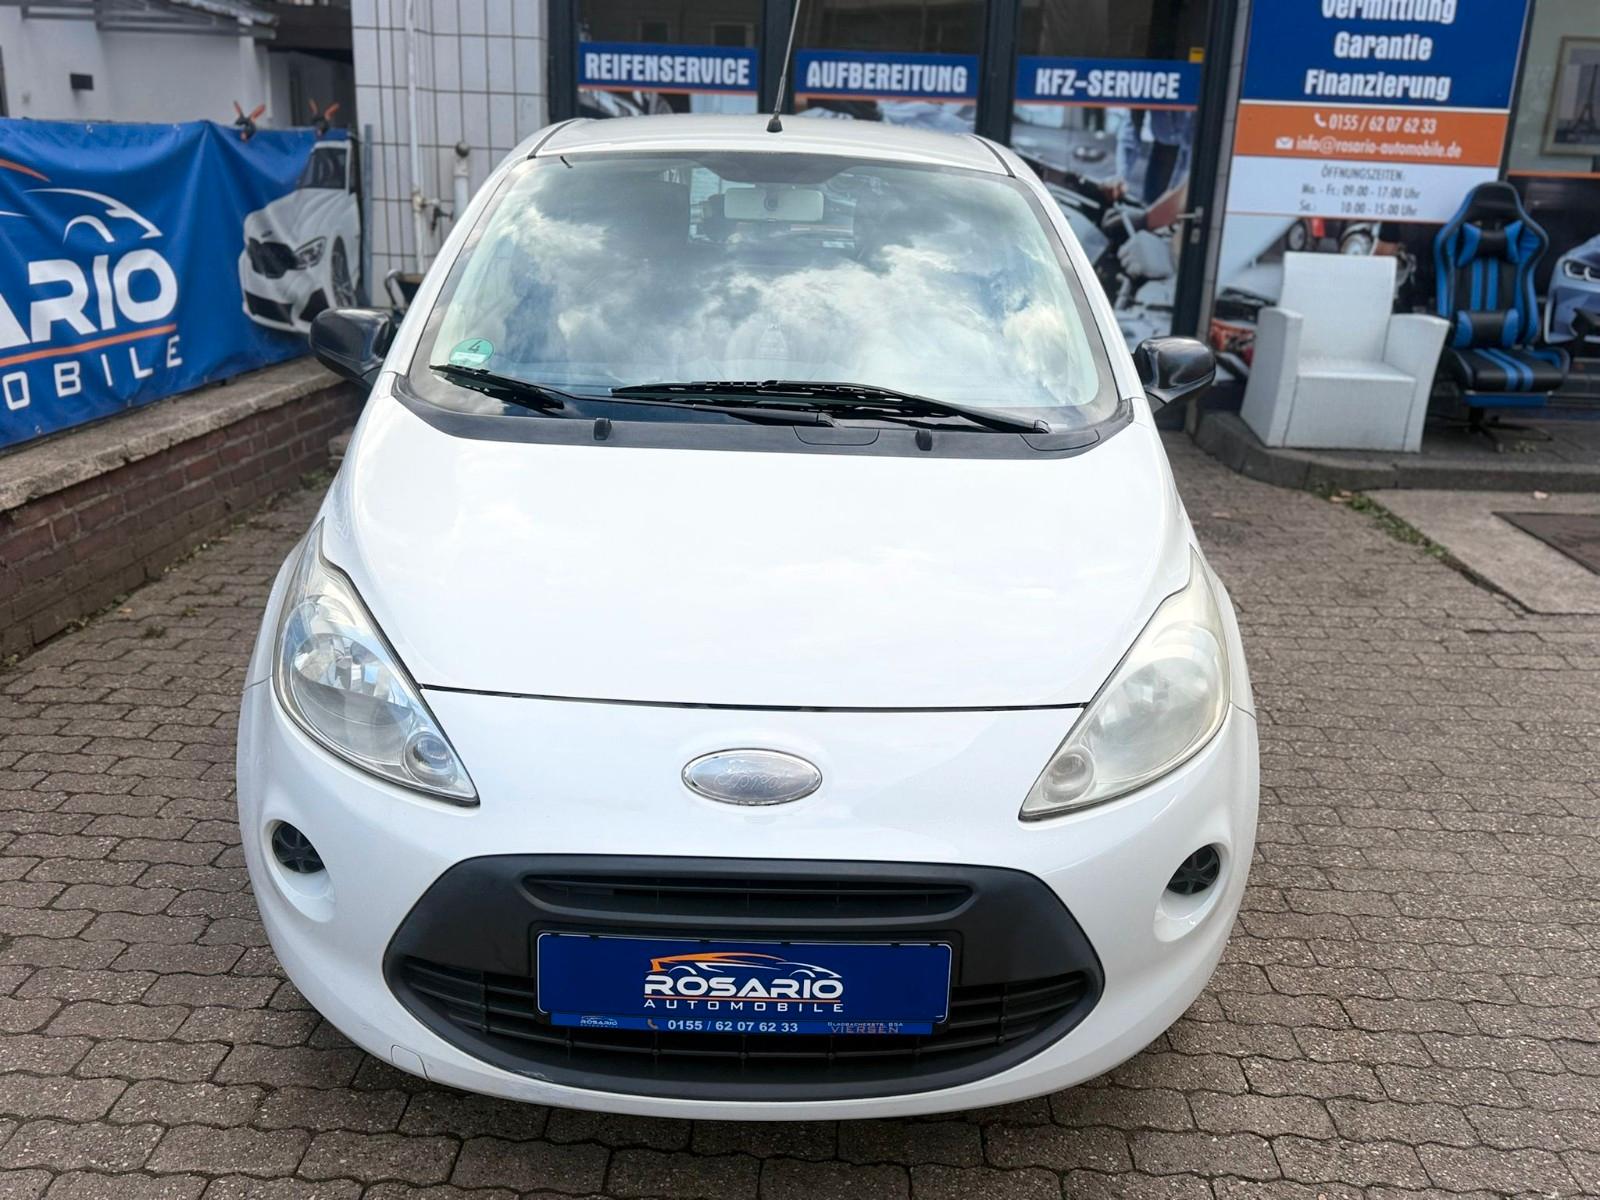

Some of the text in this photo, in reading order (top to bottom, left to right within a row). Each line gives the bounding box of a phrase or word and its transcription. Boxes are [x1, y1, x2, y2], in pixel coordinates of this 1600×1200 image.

[1321, 0, 1457, 24] Vermittlung
[1333, 31, 1433, 61] Garantie
[585, 52, 750, 85] REIFENSERVICE
[806, 61, 968, 93] AUFBEREITUNG
[1034, 68, 1181, 99] KFZ-SERVICE
[1303, 69, 1452, 101] Finanzierung
[1328, 114, 1359, 130] 0155
[1368, 116, 1385, 132] 62
[1386, 116, 1402, 133] 07
[1403, 118, 1420, 134] 62
[1420, 118, 1437, 134] 33
[1296, 134, 1462, 159] info@rosario-automobile.de
[468, 340, 482, 354] 4
[644, 975, 844, 999] ROSARIO
[643, 999, 844, 1013] AUTOMOBILE
[667, 1020, 703, 1031] 0155
[715, 1020, 733, 1031] 62
[737, 1021, 755, 1031] 07
[758, 1021, 776, 1032] 62
[780, 1022, 798, 1032] 33
